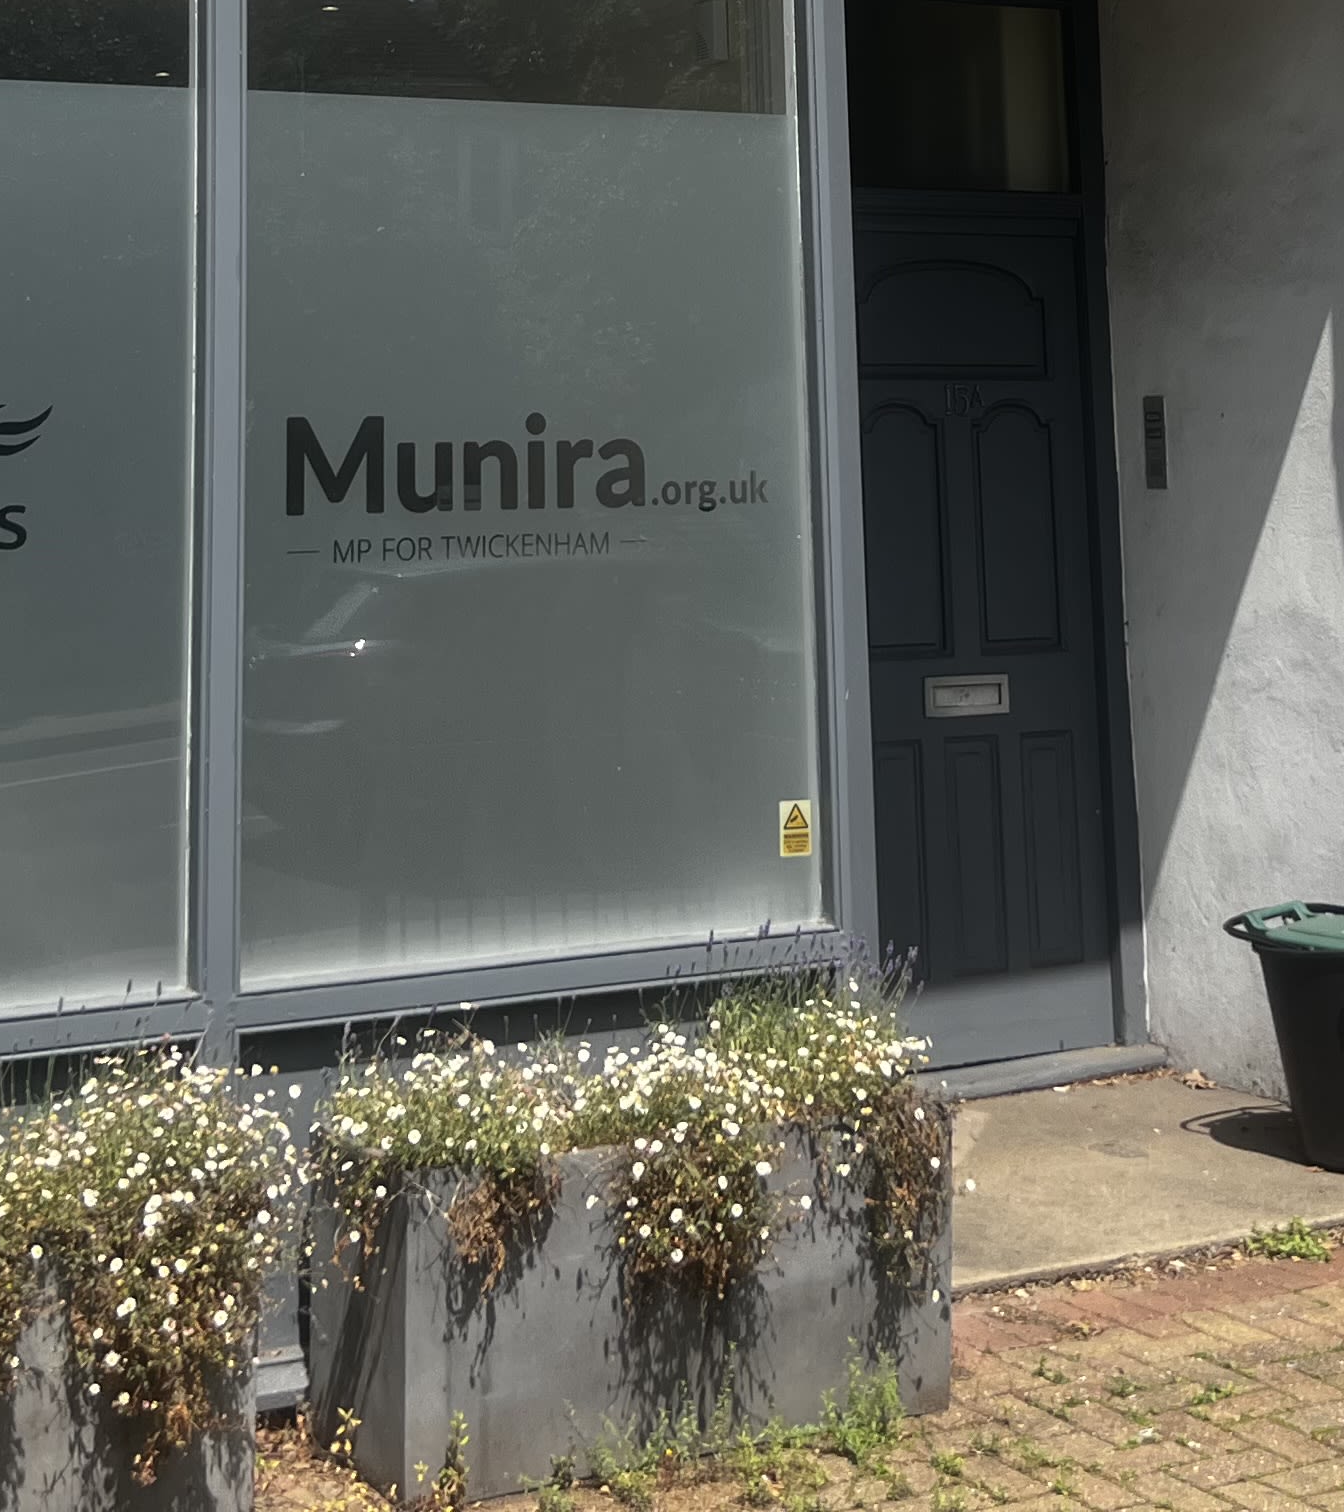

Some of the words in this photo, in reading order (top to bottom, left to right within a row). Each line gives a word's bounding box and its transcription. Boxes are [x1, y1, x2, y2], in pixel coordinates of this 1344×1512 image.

[285, 412, 769, 516] Munira.org.uk
[332, 539, 372, 564] MP
[382, 536, 434, 562] FOR
[442, 531, 610, 560] TWICKENHAM
